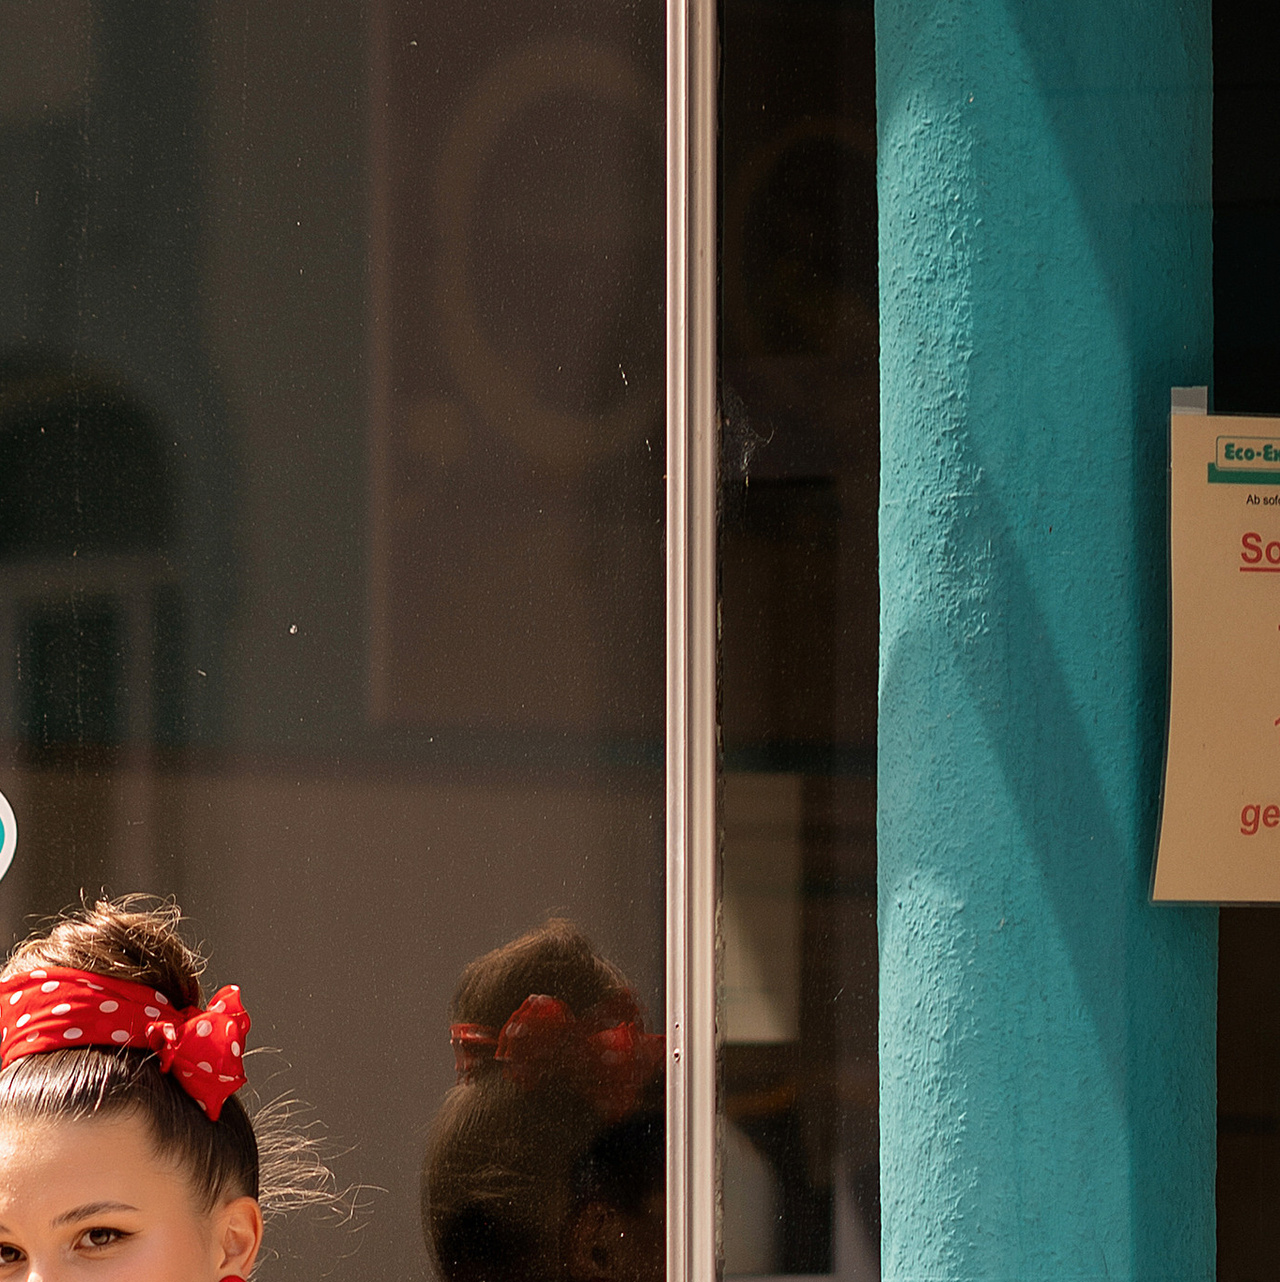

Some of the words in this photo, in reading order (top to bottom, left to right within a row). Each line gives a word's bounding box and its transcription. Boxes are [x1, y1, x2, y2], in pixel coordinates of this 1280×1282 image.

[1246, 494, 1260, 505] Ab
[1263, 494, 1280, 506] sof
[1241, 532, 1280, 564] So
[1240, 804, 1280, 836] ge
